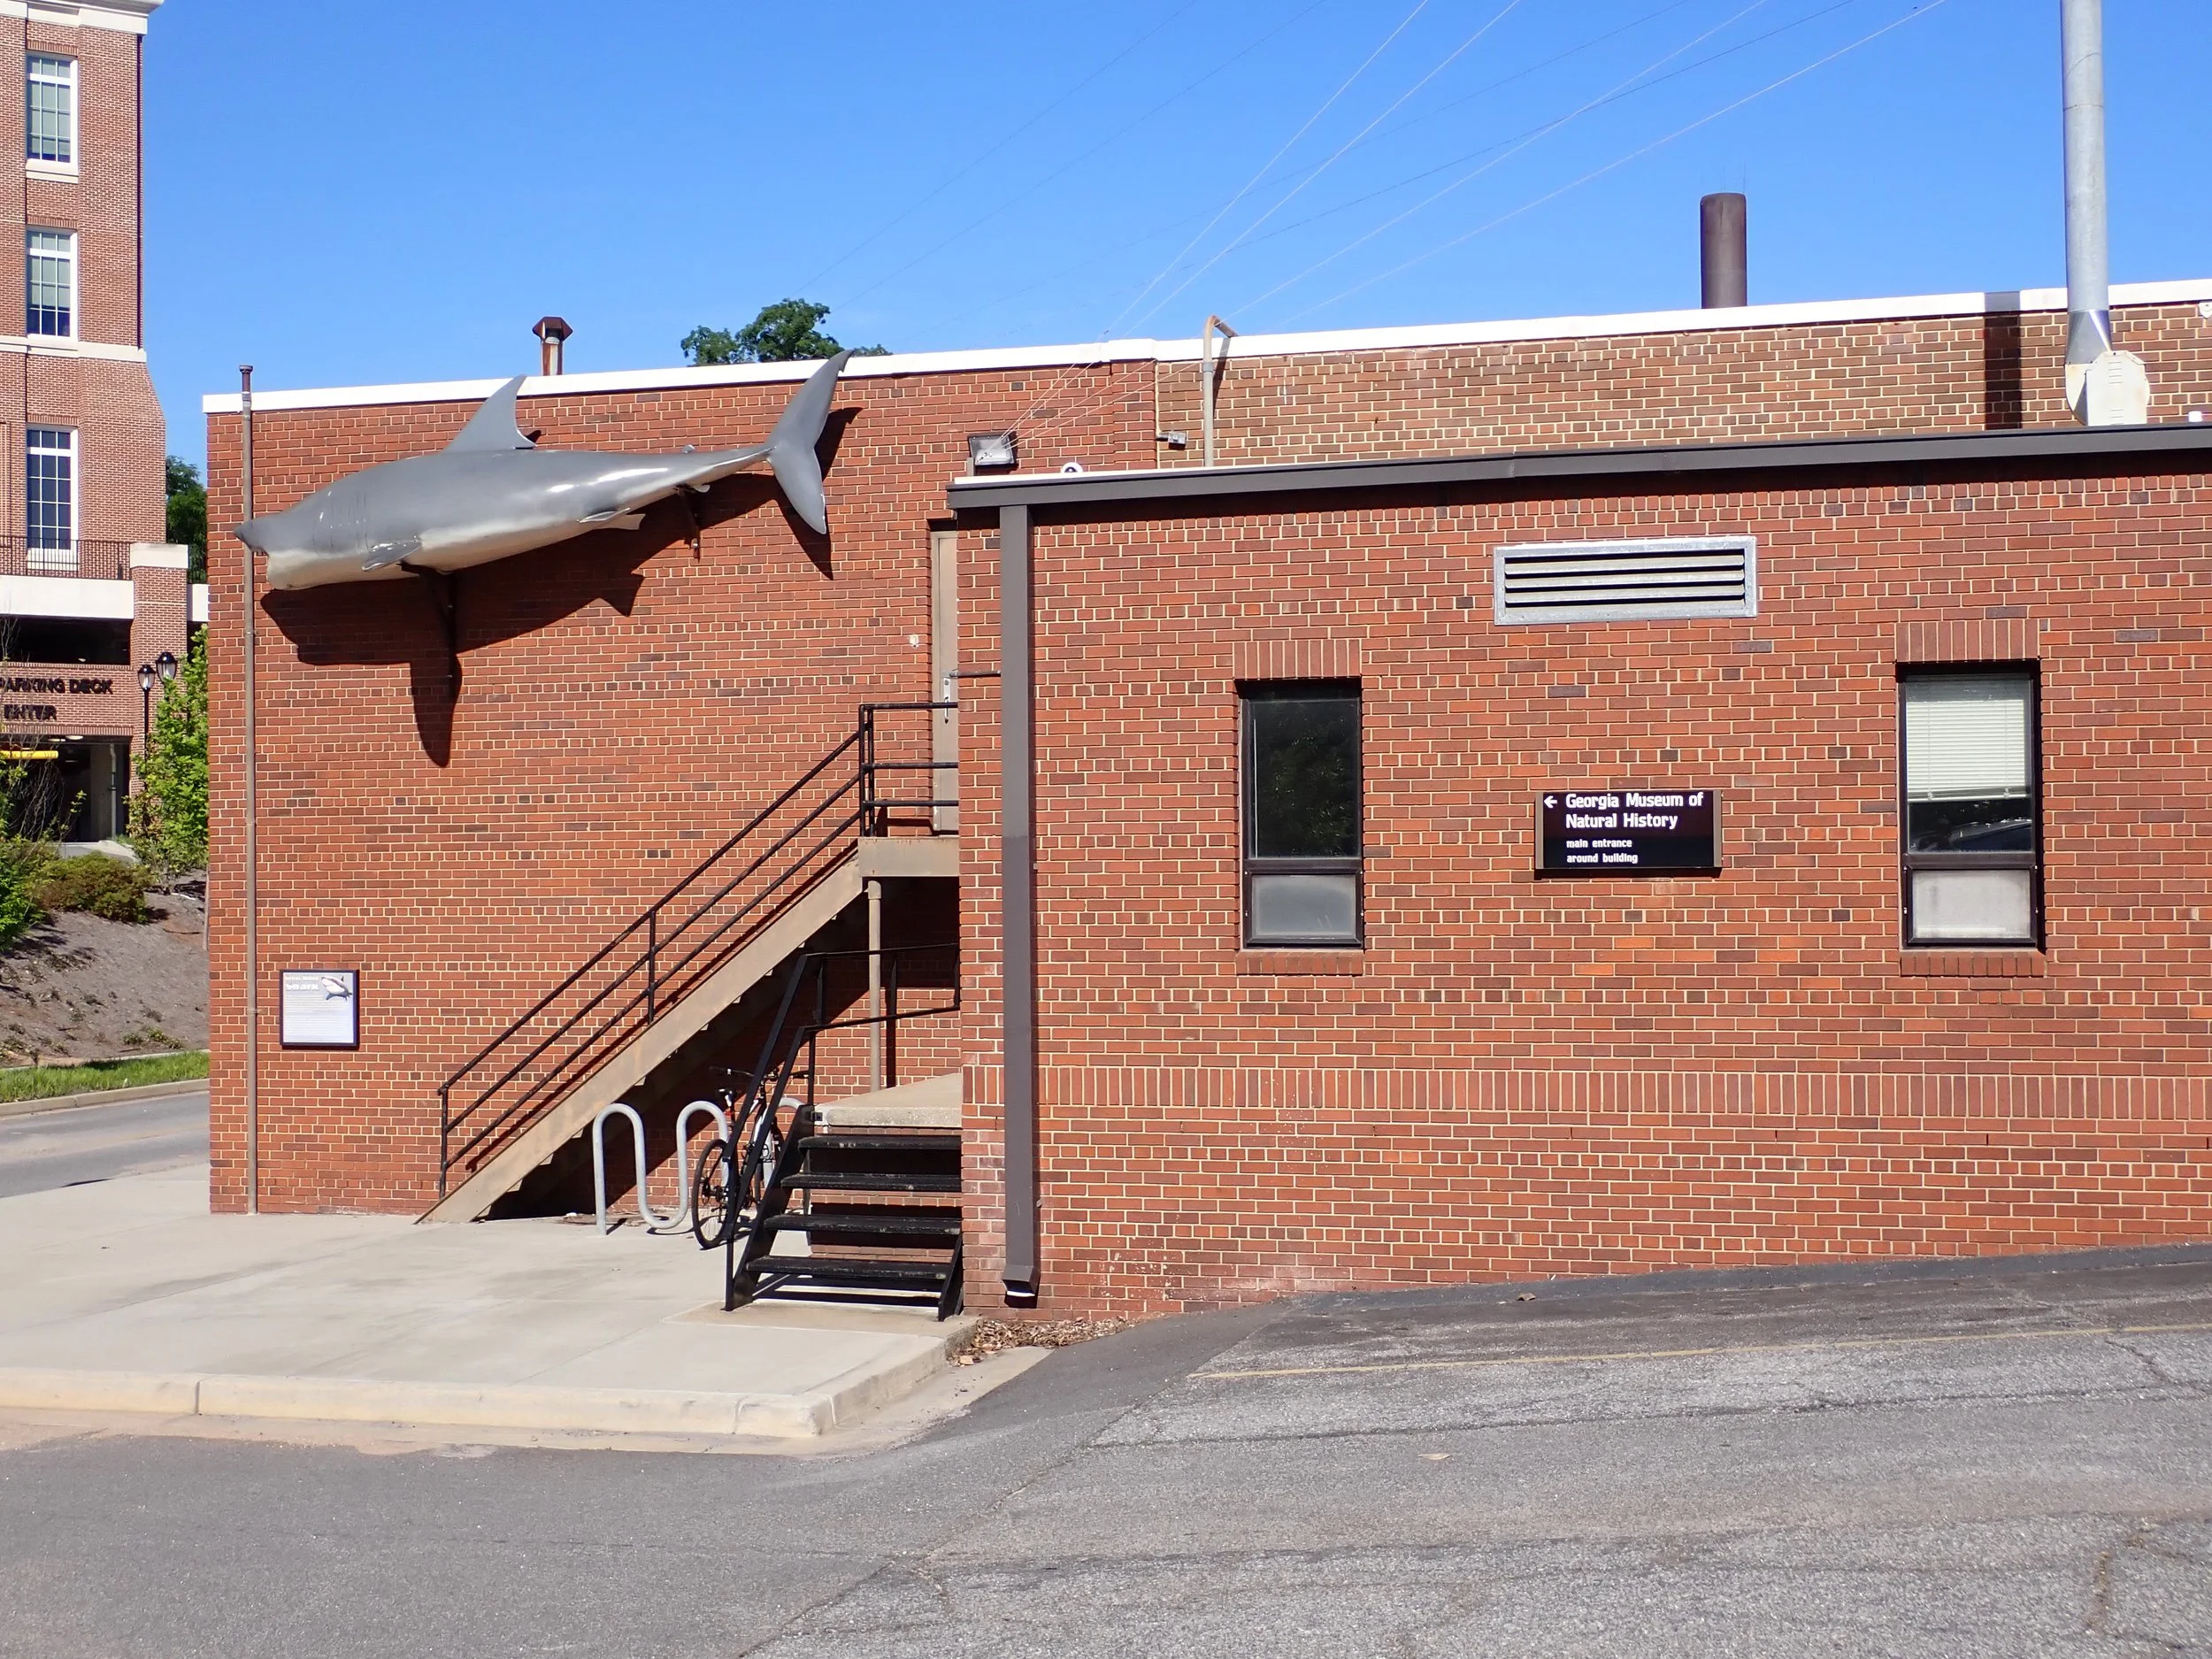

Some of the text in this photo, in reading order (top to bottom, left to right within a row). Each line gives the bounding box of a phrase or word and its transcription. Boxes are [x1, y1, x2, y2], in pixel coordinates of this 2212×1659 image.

[69, 679, 113, 695] DECK
[4, 704, 57, 720] ENTER
[1565, 791, 1704, 810] Georgia Museum of
[1565, 812, 1678, 830] Natural History
[1565, 838, 1632, 849] main entrance
[1566, 852, 1639, 864] around building
